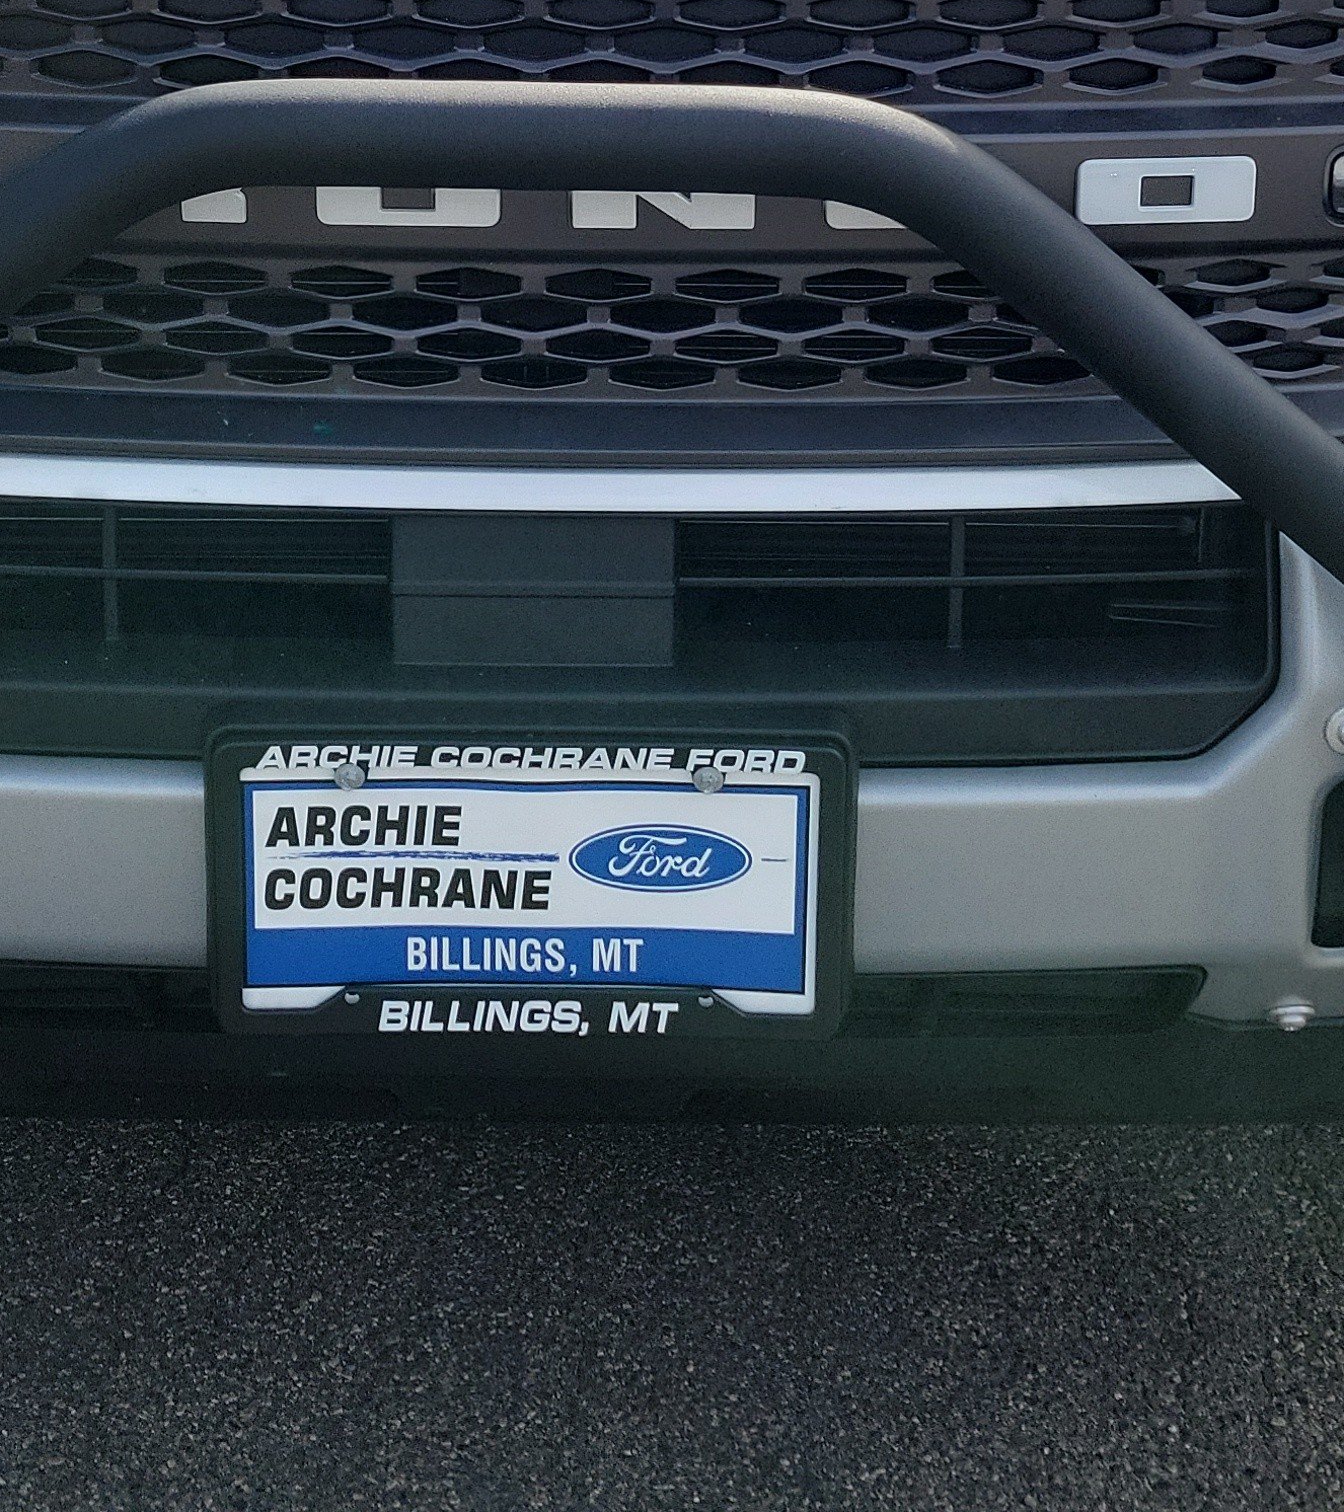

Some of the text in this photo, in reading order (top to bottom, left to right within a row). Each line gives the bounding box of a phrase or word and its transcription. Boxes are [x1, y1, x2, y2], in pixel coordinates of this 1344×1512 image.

[256, 745, 806, 775] ARCHIE COCHRANE FORD
[265, 804, 462, 848] ARCHIE
[606, 834, 713, 879] Ford
[264, 867, 551, 911] COCHRANE
[405, 936, 644, 978] BILLINGS, MT
[377, 999, 679, 1036] BILLINGS, MT
